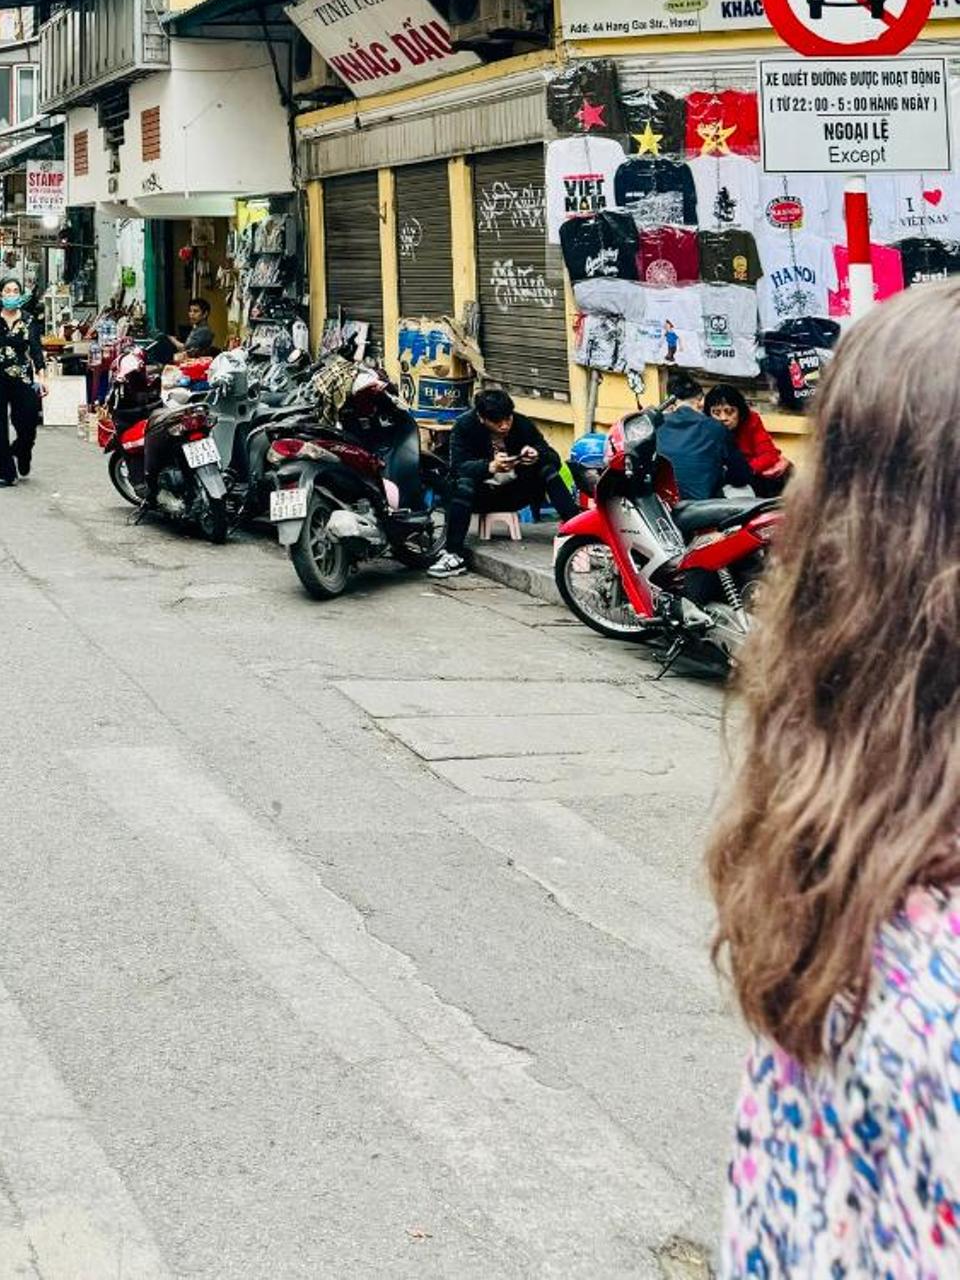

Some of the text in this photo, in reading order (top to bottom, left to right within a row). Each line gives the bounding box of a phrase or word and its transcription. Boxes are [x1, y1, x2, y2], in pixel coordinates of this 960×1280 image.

[329, 37, 401, 84] KHẮC
[765, 68, 940, 89] XE QUÉT ĐƯỜNG ĐƯỢC HOẠT ĐỘNG
[870, 93, 898, 111] HÀNG
[824, 118, 890, 144] NGOẠI LỆ
[828, 145, 886, 166] Except
[29, 172, 65, 187] STAMP
[771, 266, 816, 289] HANOI
